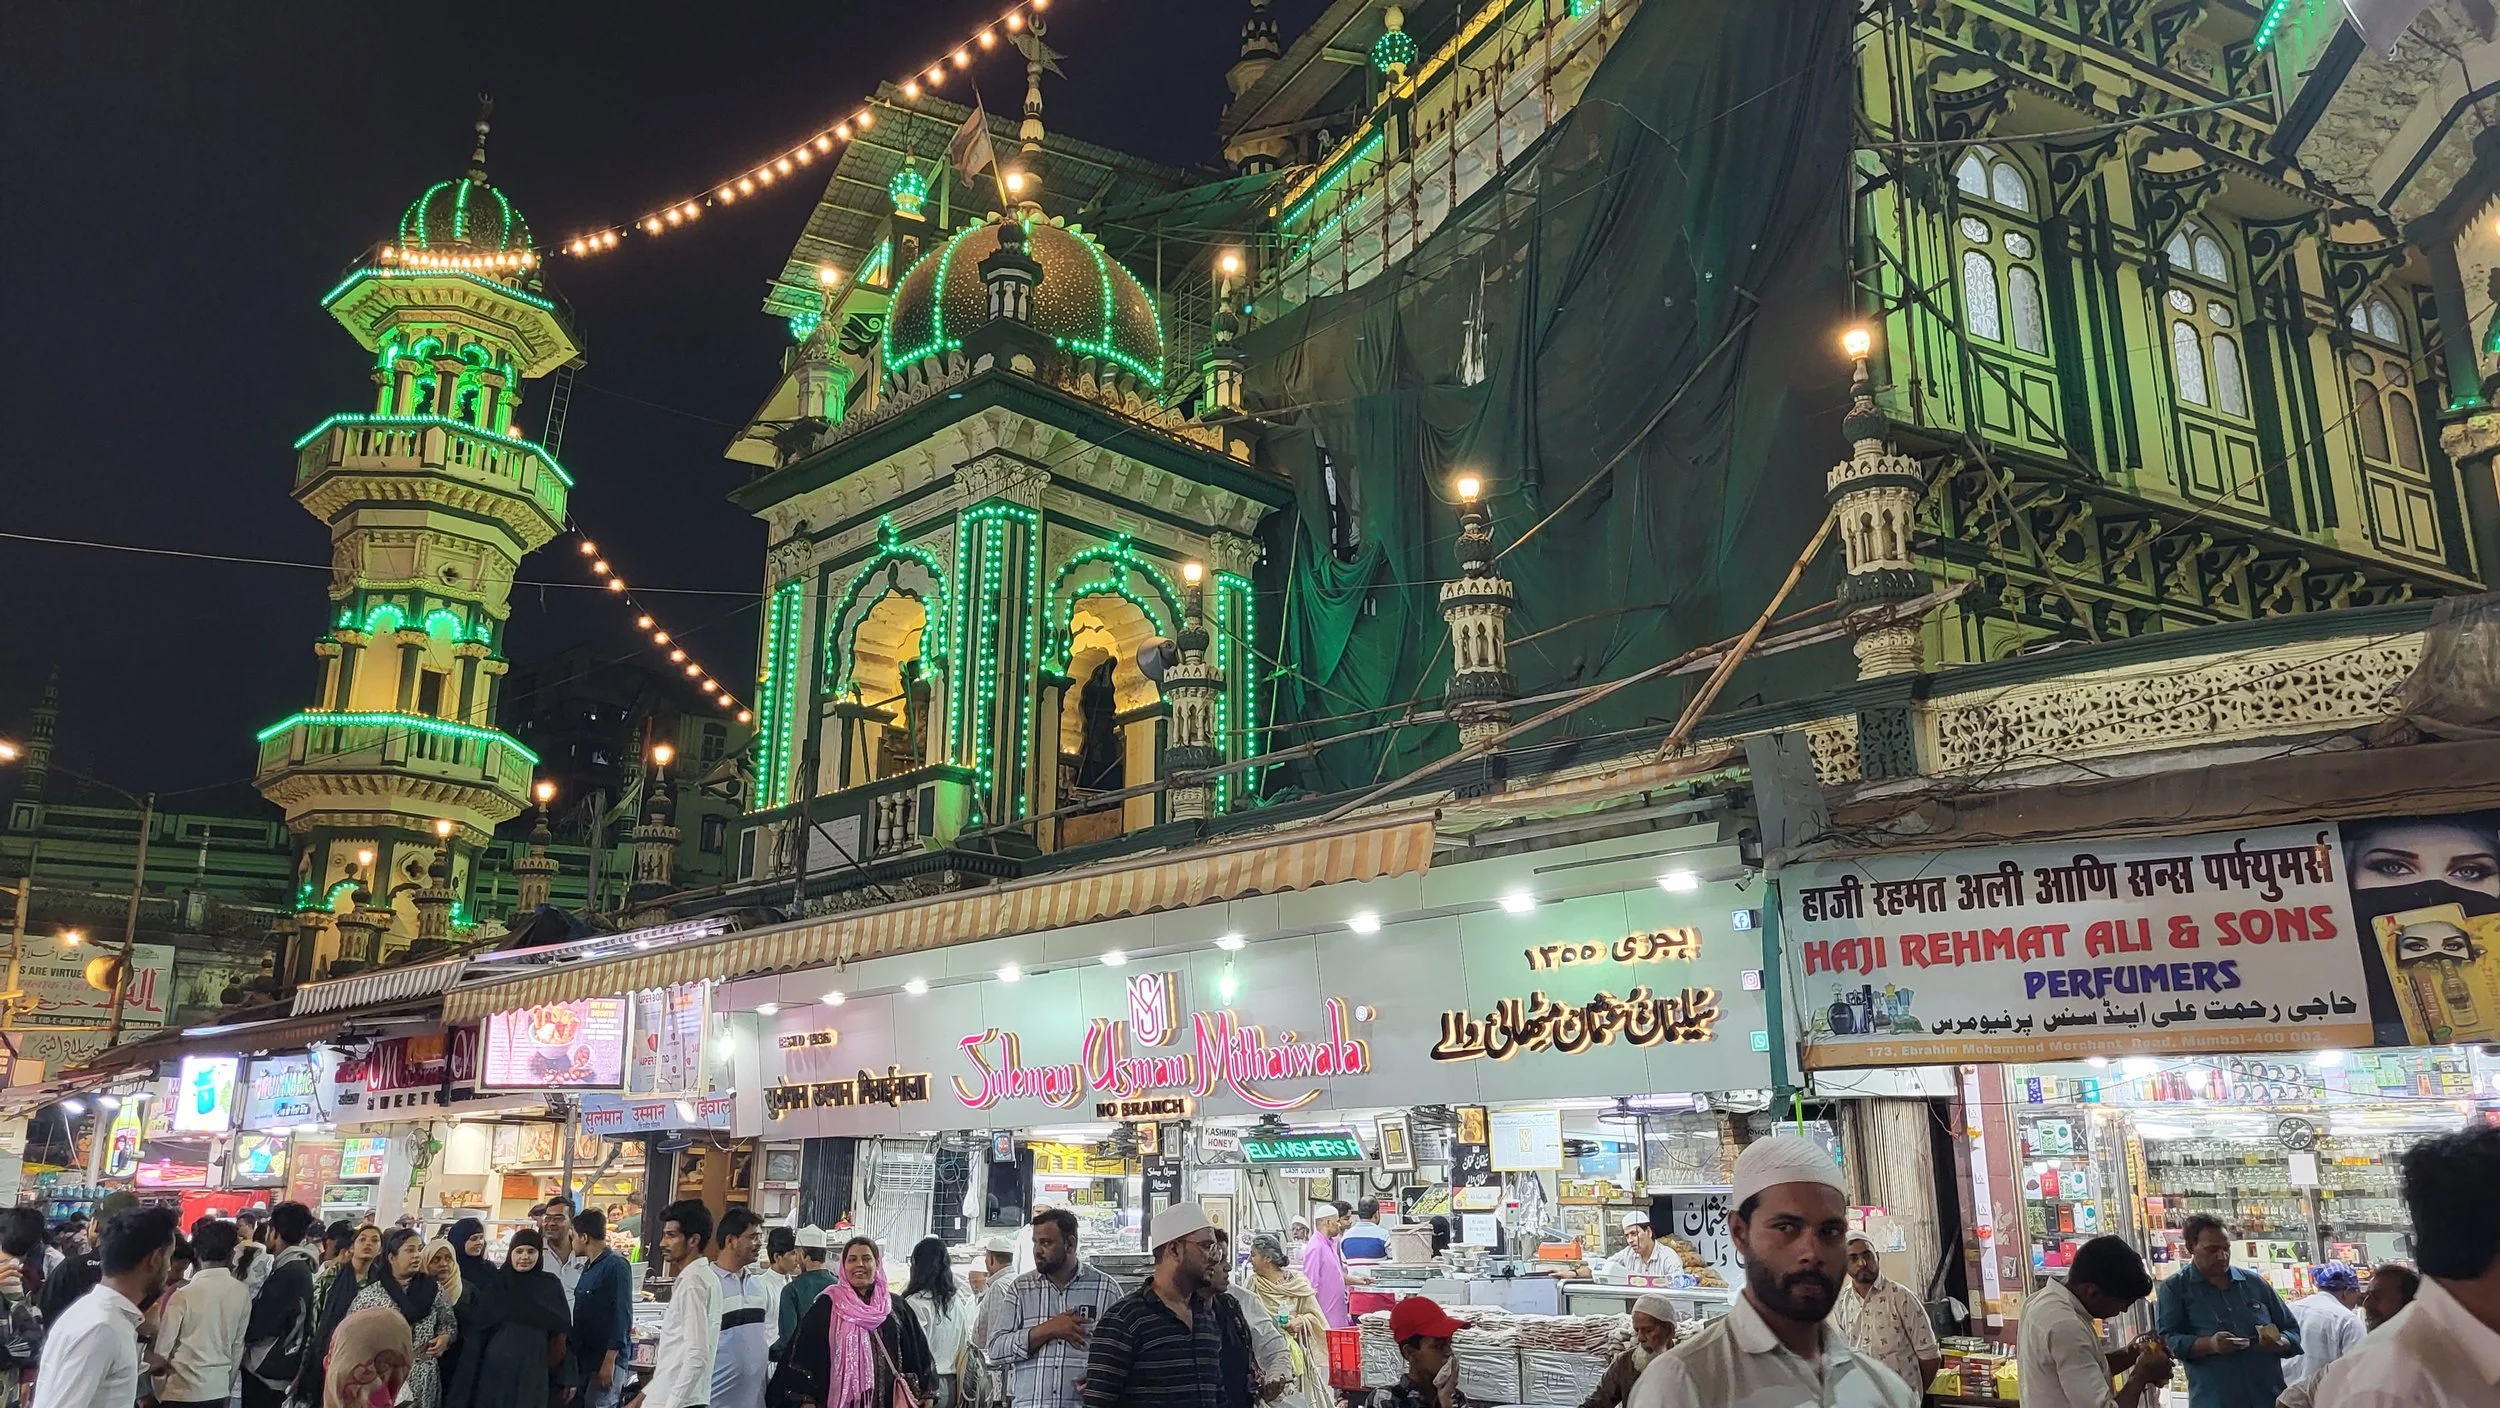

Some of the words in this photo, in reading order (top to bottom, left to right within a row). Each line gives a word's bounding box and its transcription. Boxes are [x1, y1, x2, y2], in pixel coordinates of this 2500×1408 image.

[1800, 875, 1863, 921] हाजी
[1870, 877, 1947, 917] रहमत
[1956, 860, 2024, 910] अली
[2033, 854, 2117, 904] आणि
[2124, 856, 2195, 897] सन्स
[1804, 936, 1887, 976] HAJI
[1900, 923, 2070, 969] REHMAT
[2085, 918, 2152, 959] ALI
[2168, 915, 2199, 948] &
[2214, 905, 2337, 946] SONS
[28, 966, 48, 976] ARE
[50, 967, 85, 979] VIRTUE
[2024, 959, 2241, 1000] PERFUMERS
[2043, 1006, 2098, 1032] سنس
[2203, 998, 2281, 1023] رحمت
[950, 1030, 1073, 1108] Suleman
[1082, 1019, 1187, 1099] Usman
[1190, 997, 1363, 1109] Mithaiwala
[1901, 1044, 1957, 1056] Ebrahim
[1962, 1041, 2044, 1055] Mohammed
[2049, 1038, 2121, 1051] Merchant
[585, 1105, 624, 1133] सुलेमान
[632, 1104, 666, 1122] उस्मान
[1096, 1101, 1117, 1118] NO
[1121, 1098, 1185, 1116] BRANCH
[1205, 1127, 1238, 1138] KASHMIRI
[1207, 1138, 1234, 1148] HONEY
[1285, 1167, 1300, 1175] CASH
[1301, 1167, 1325, 1175] COUNTER
